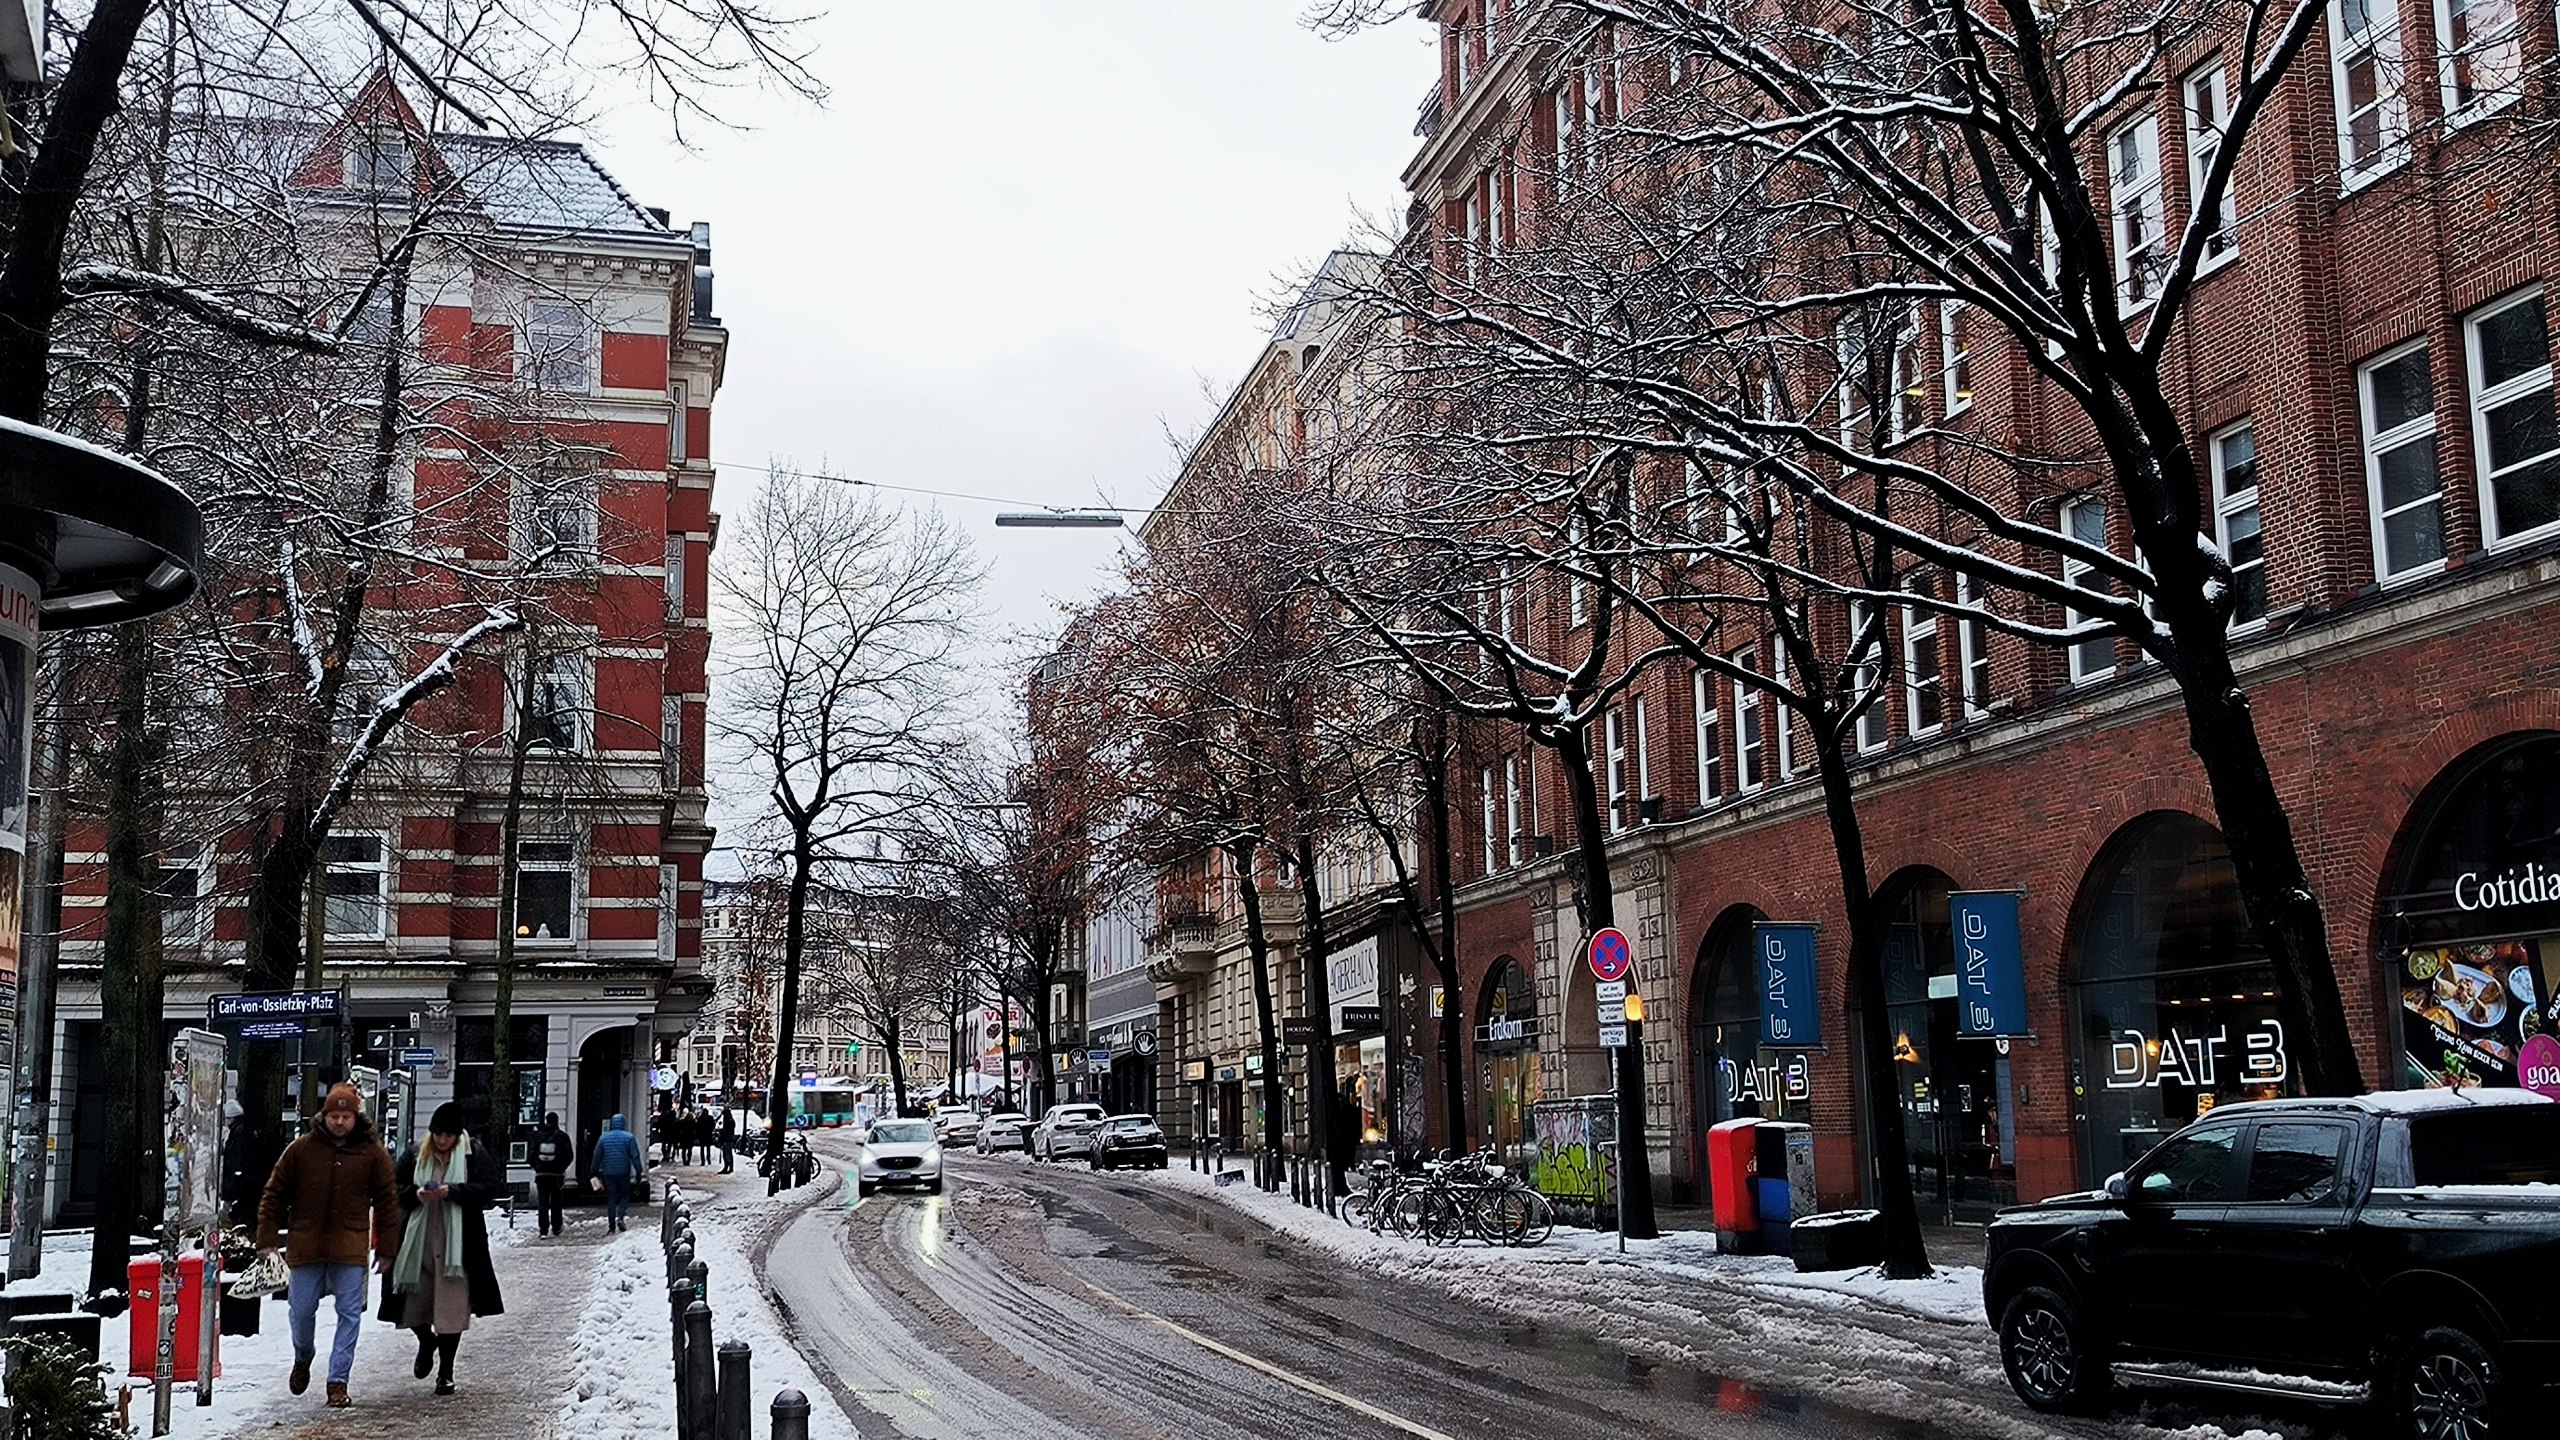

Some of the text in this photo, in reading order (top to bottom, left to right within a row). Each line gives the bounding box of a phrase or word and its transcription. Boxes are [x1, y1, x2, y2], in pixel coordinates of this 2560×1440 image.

[2455, 862, 2560, 911] Cotidia
[1330, 947, 1375, 995] AGERHAUS
[1765, 934, 1791, 1040] DAT B
[1963, 908, 1994, 1031] DAT B
[219, 995, 334, 1014] Carl-von-Ossietzky-Platz
[1489, 1014, 1522, 1041] Erdkorn
[1785, 1054, 1810, 1101] B
[2106, 1019, 2288, 1089] DAT B
[2527, 1066, 2560, 1090] goa
